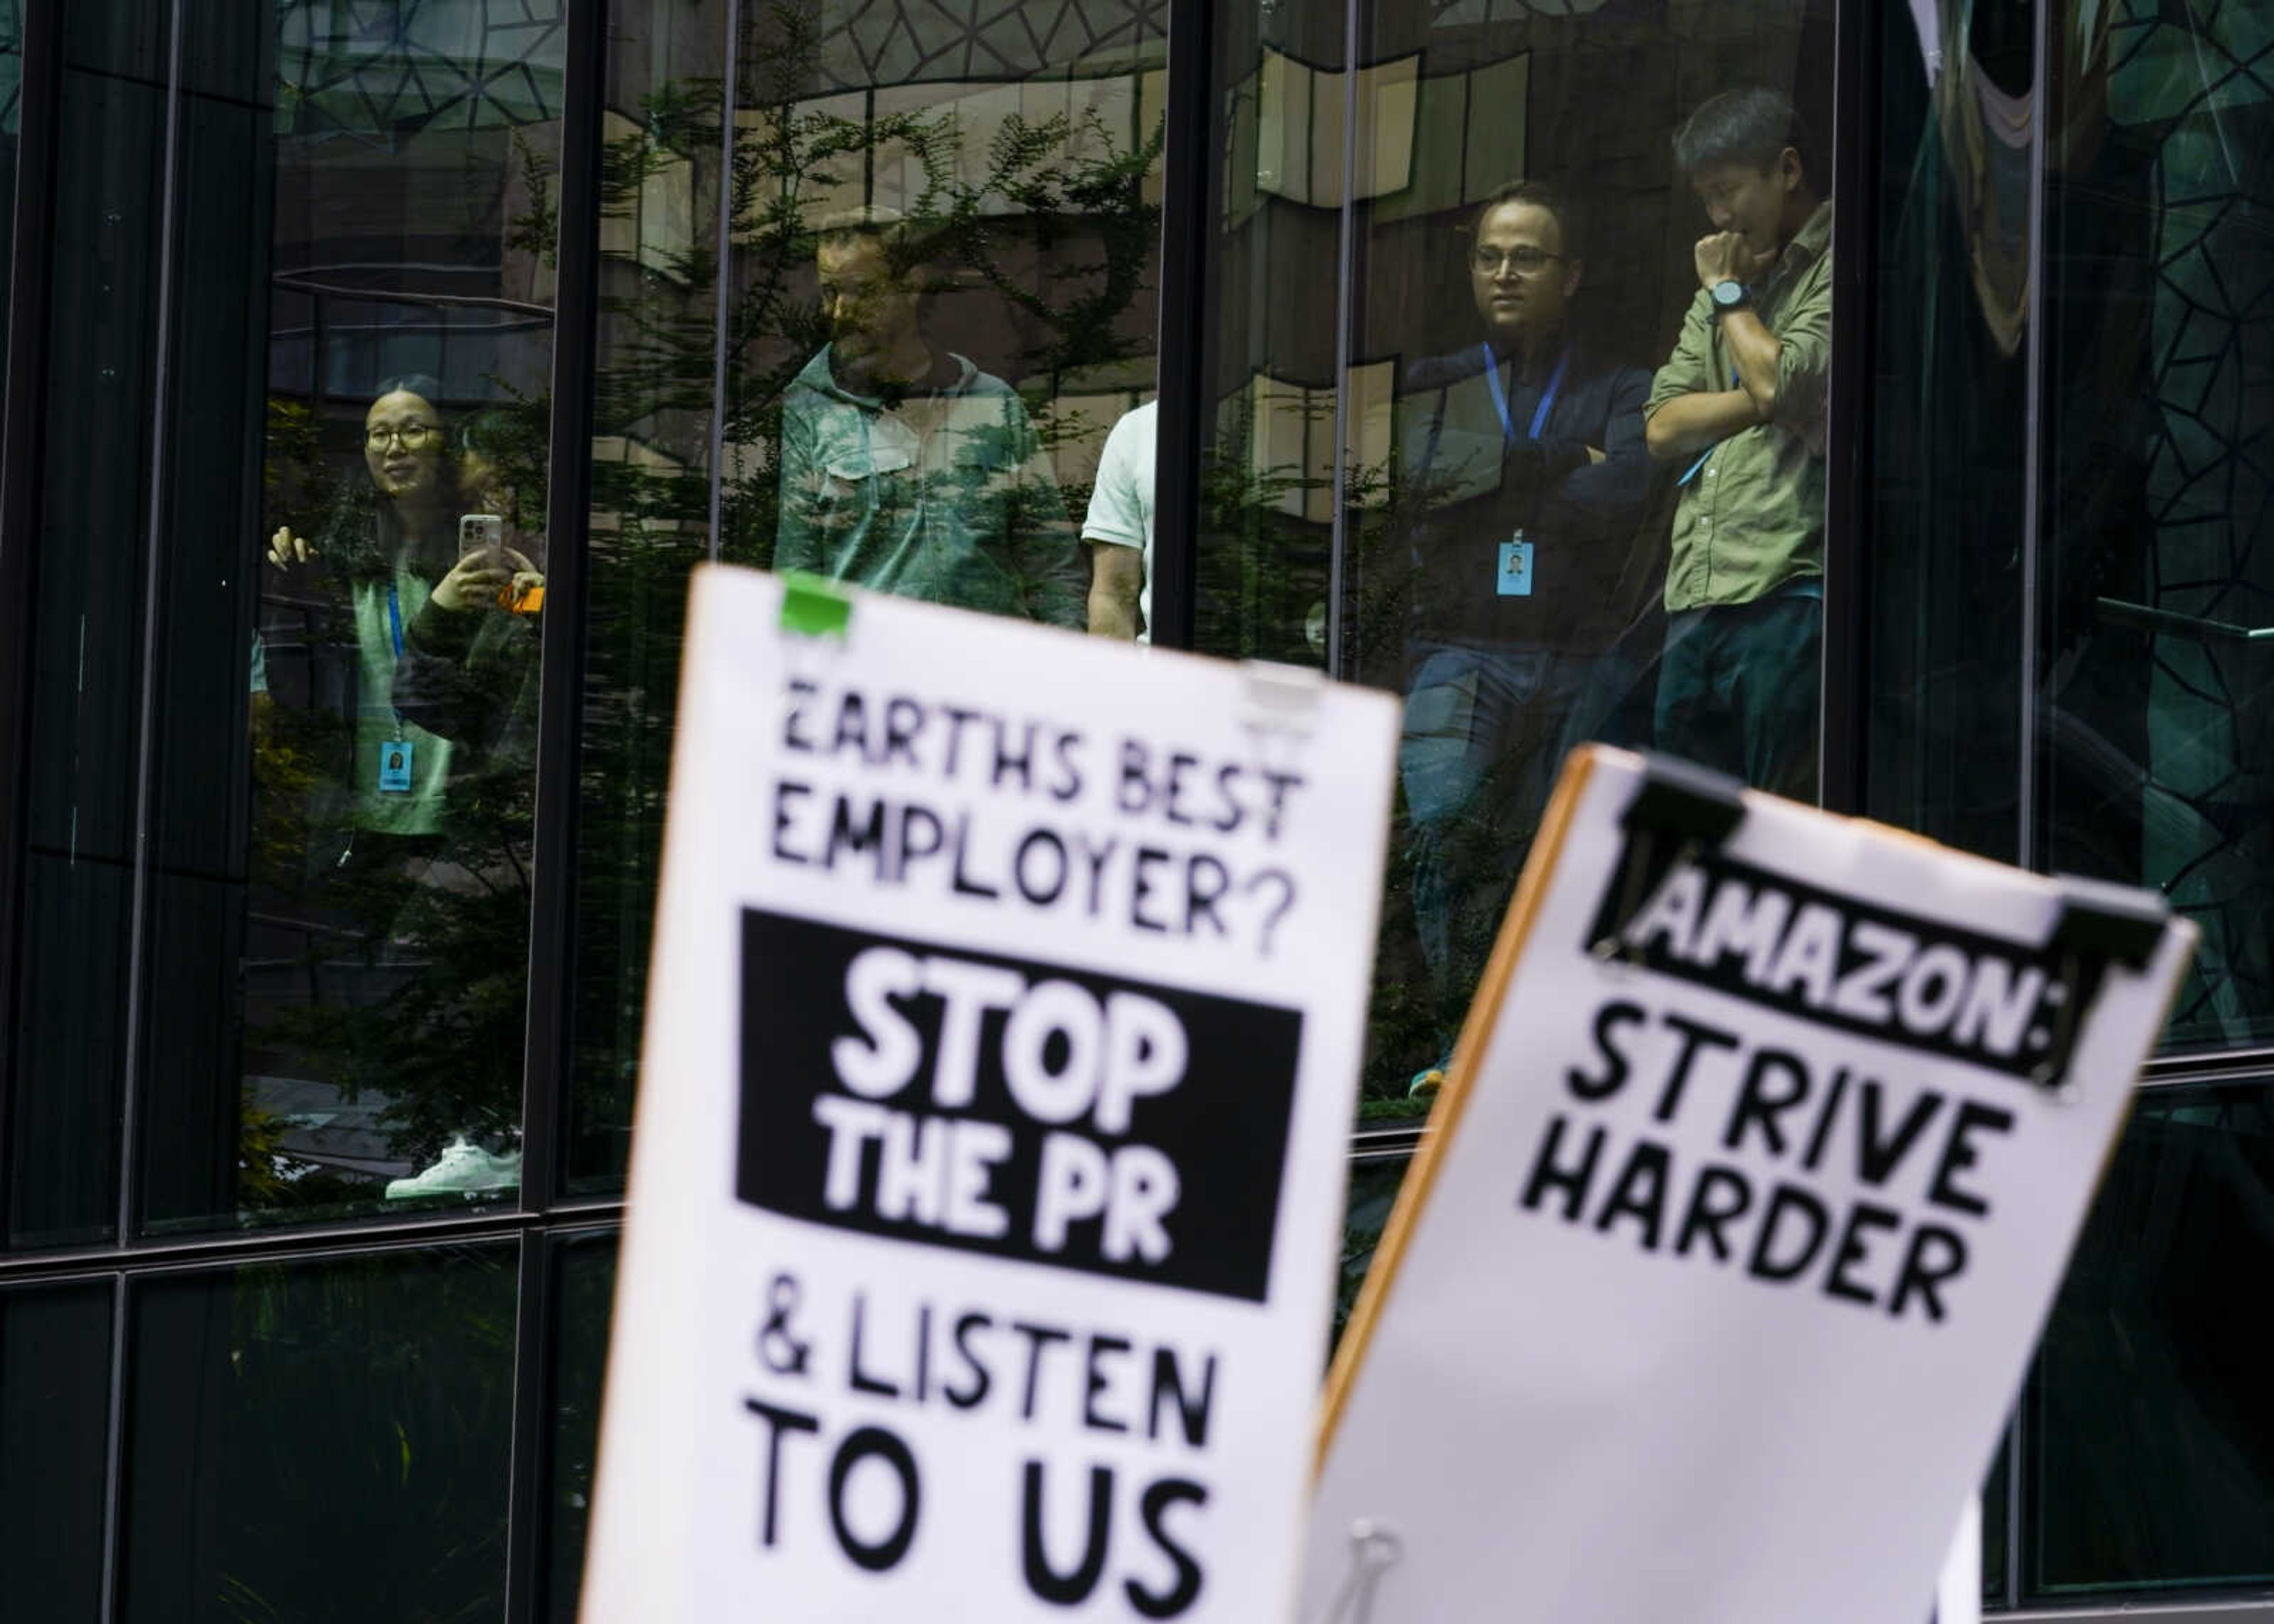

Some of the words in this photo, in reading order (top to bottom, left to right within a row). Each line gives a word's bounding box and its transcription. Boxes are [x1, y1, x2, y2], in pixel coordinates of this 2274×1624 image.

[772, 780, 1296, 956] EMPLOYER?
[1117, 738, 1303, 841] BEST
[830, 944, 1189, 1136] STOP
[1623, 863, 2069, 1056] AMAZON:
[812, 1092, 1013, 1240] THE
[1031, 1131, 1180, 1265] PR
[1566, 1000, 2017, 1221] STRIVE
[1519, 1115, 1970, 1323] HARDER
[759, 1273, 811, 1376] &
[848, 1293, 1217, 1449] LISTEN
[744, 1397, 921, 1572] TO
[1021, 1460, 1208, 1621] US
